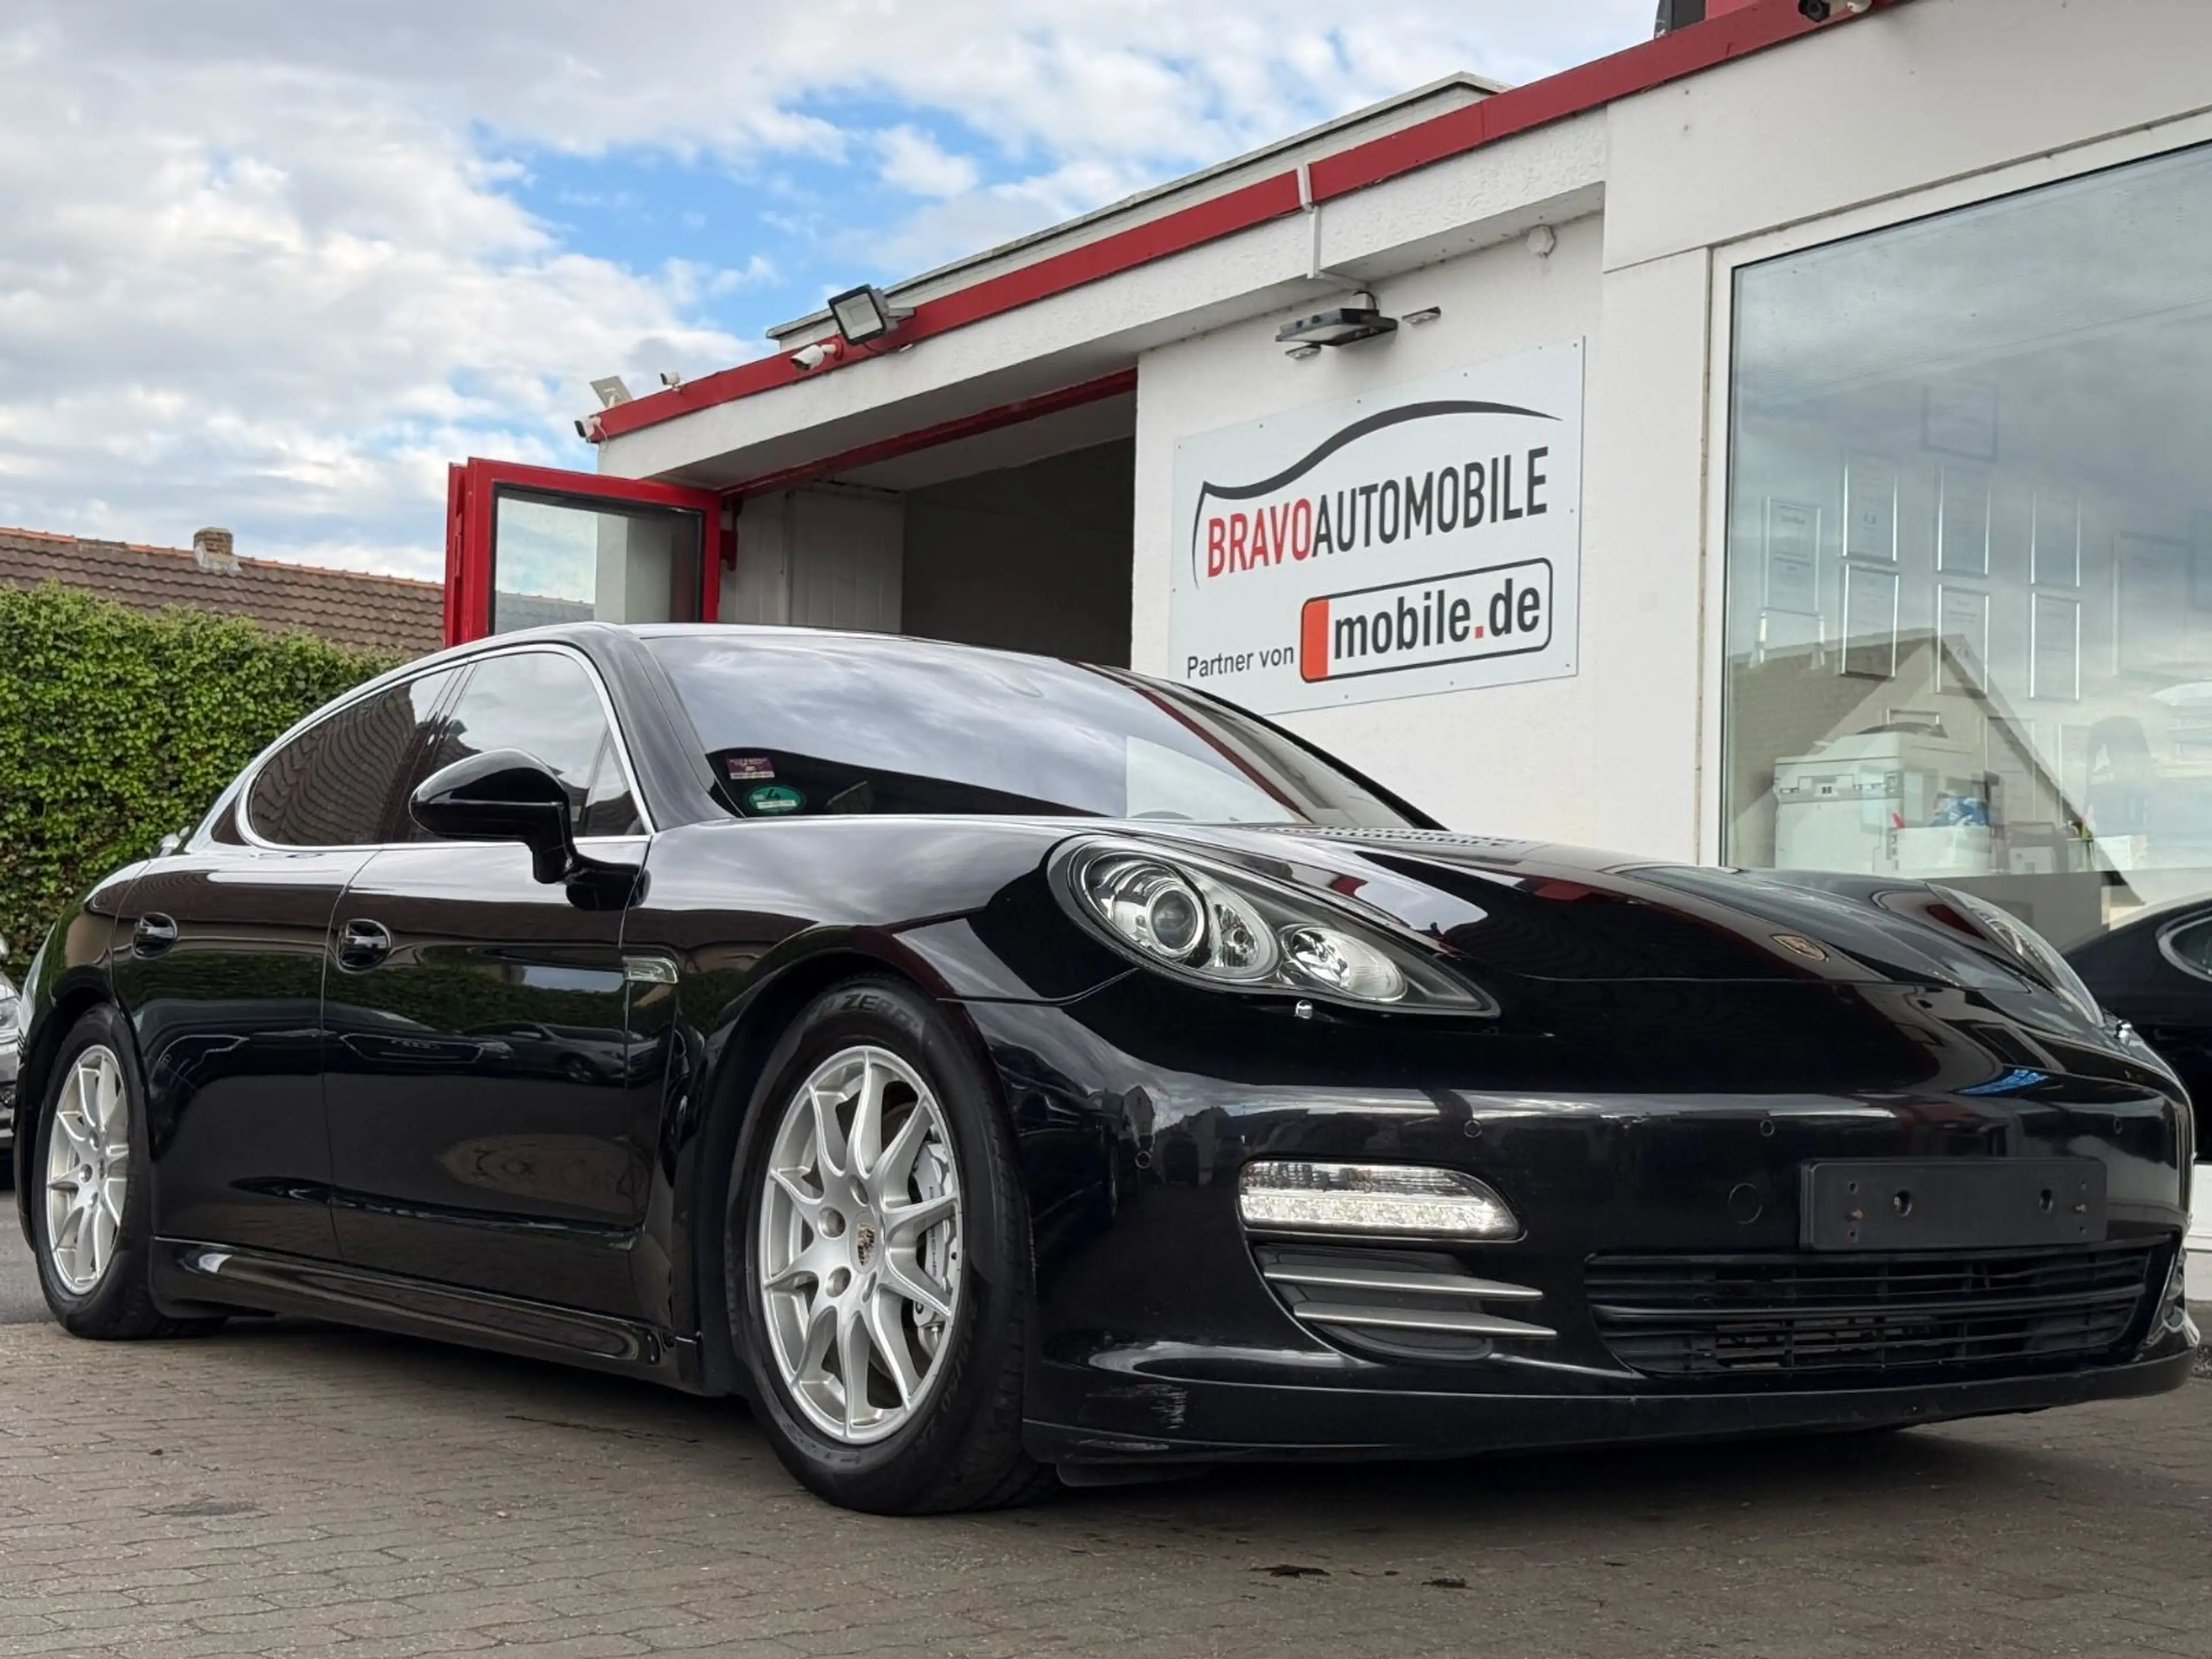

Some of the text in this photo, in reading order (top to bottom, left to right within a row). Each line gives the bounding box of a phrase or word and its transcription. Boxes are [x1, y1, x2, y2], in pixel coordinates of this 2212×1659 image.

[1187, 578, 1541, 679] Partner von mobile.de
[840, 993, 912, 1029] ZERO
